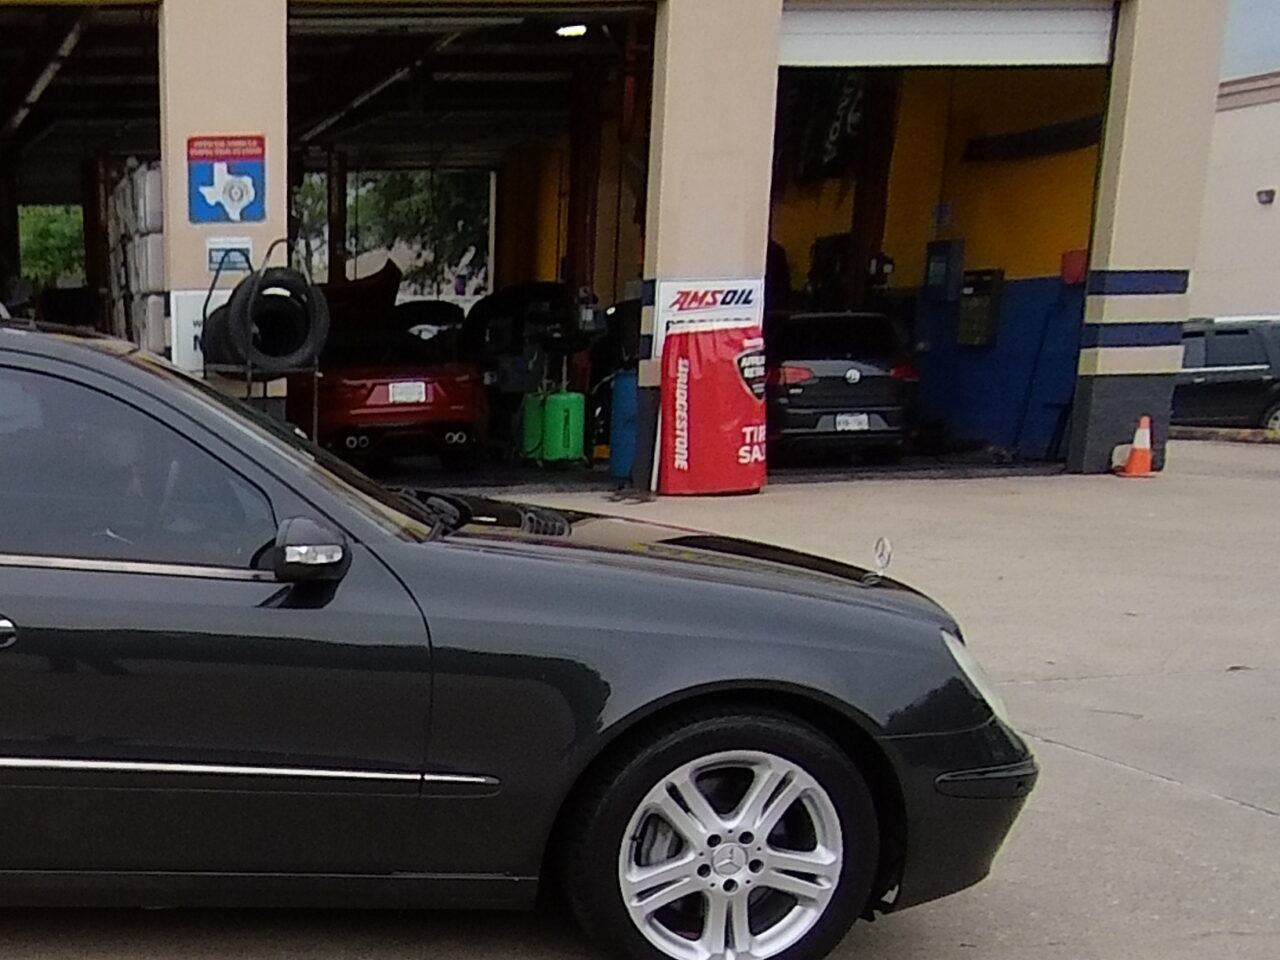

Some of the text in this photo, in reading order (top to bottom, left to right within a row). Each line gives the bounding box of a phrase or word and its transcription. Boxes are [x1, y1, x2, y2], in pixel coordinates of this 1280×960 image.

[669, 288, 753, 312] AMSOIL
[675, 356, 689, 471] BRIDGESTONE
[741, 424, 766, 445] TIR
